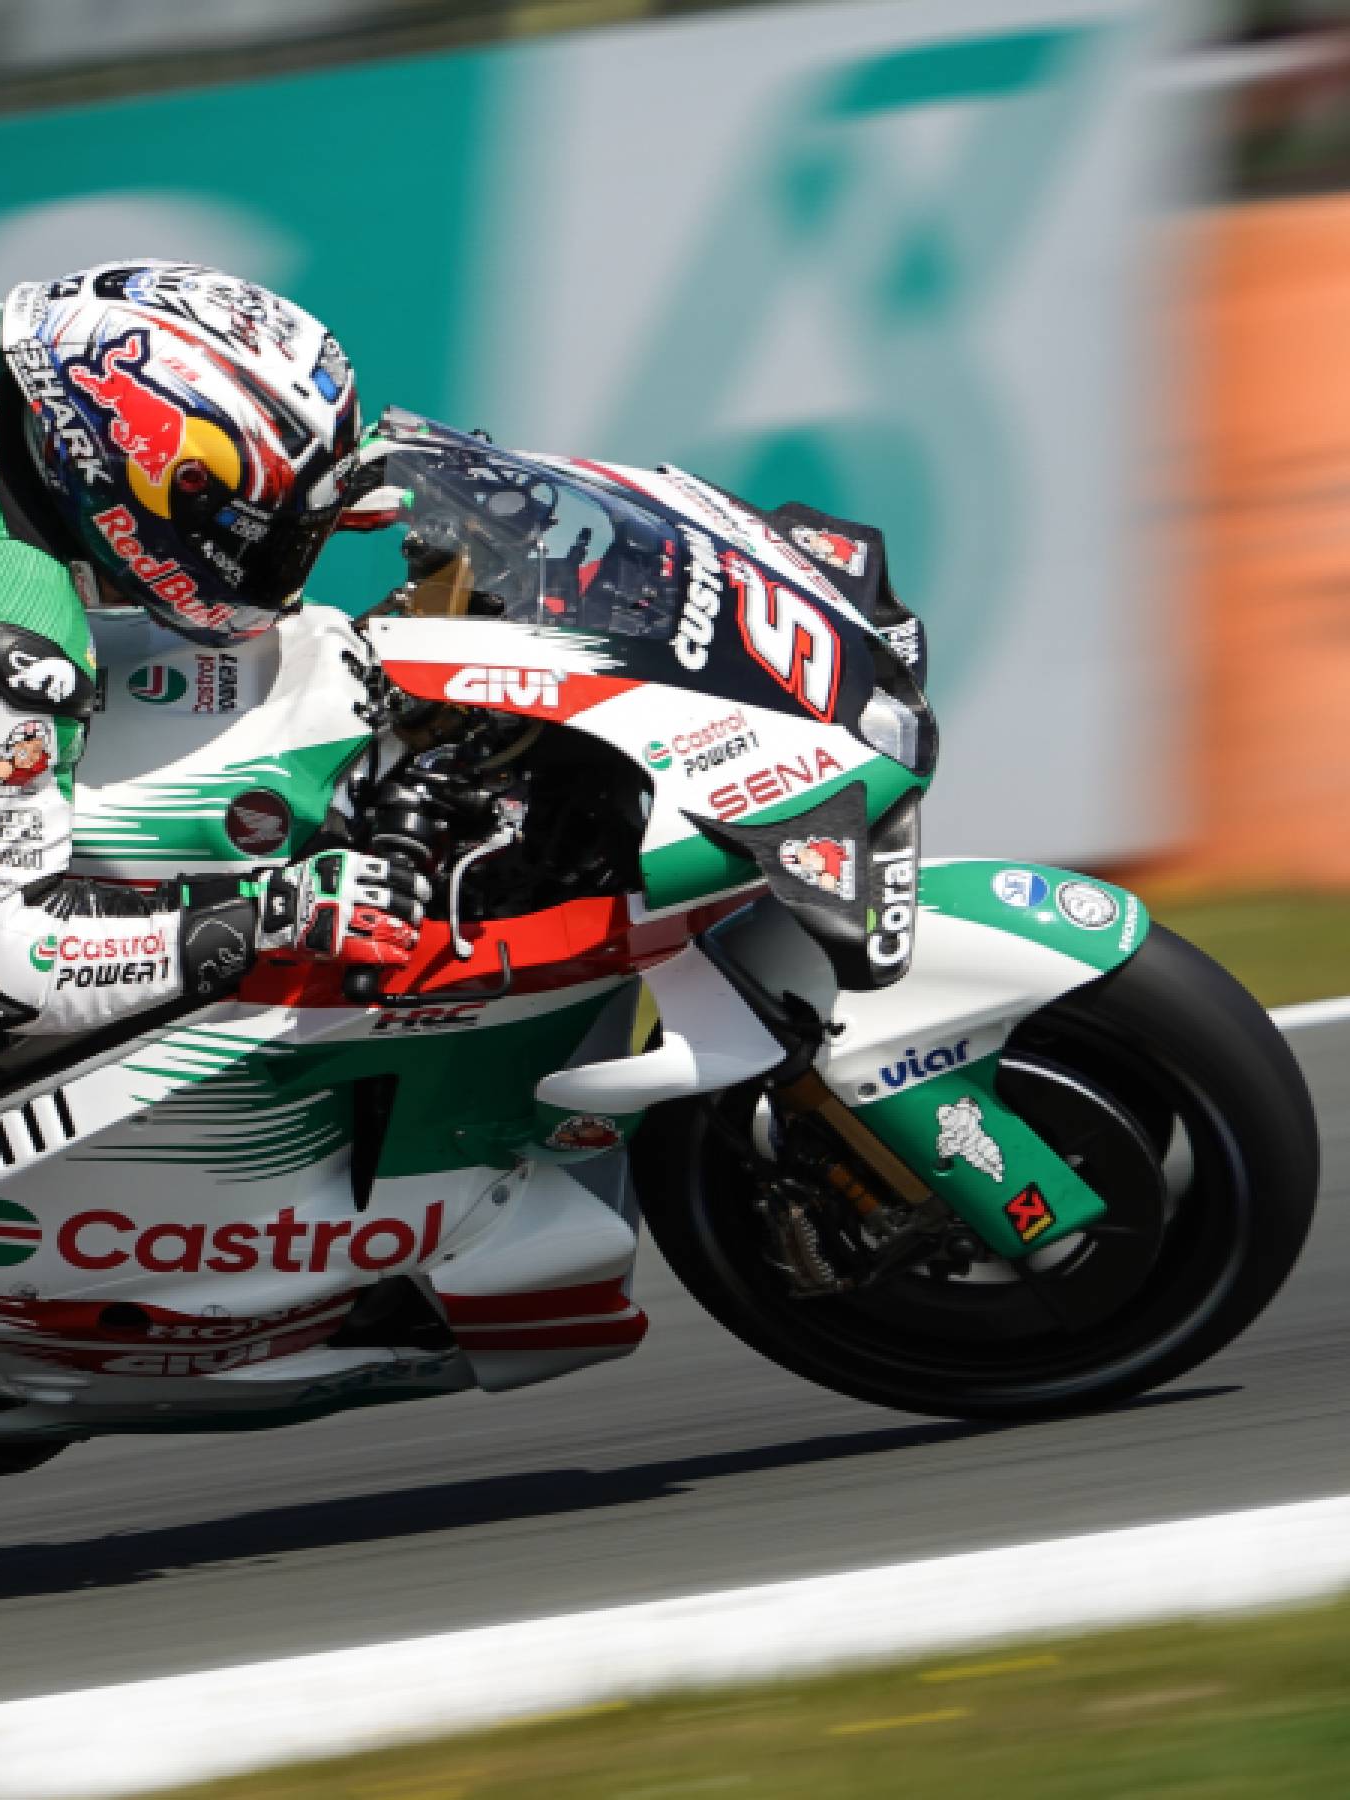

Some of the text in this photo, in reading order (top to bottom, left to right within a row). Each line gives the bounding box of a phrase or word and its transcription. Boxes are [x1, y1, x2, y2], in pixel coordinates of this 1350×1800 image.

[17, 338, 114, 486] SHARK
[92, 503, 177, 584] Red
[722, 550, 841, 725] 5
[444, 666, 559, 707] GIVI
[670, 708, 747, 758] Castrol
[708, 746, 843, 821] SENA
[867, 847, 914, 967] Coral
[58, 929, 168, 962] Castrol
[879, 1037, 970, 1090] viar
[56, 1203, 445, 1273] Castrol
